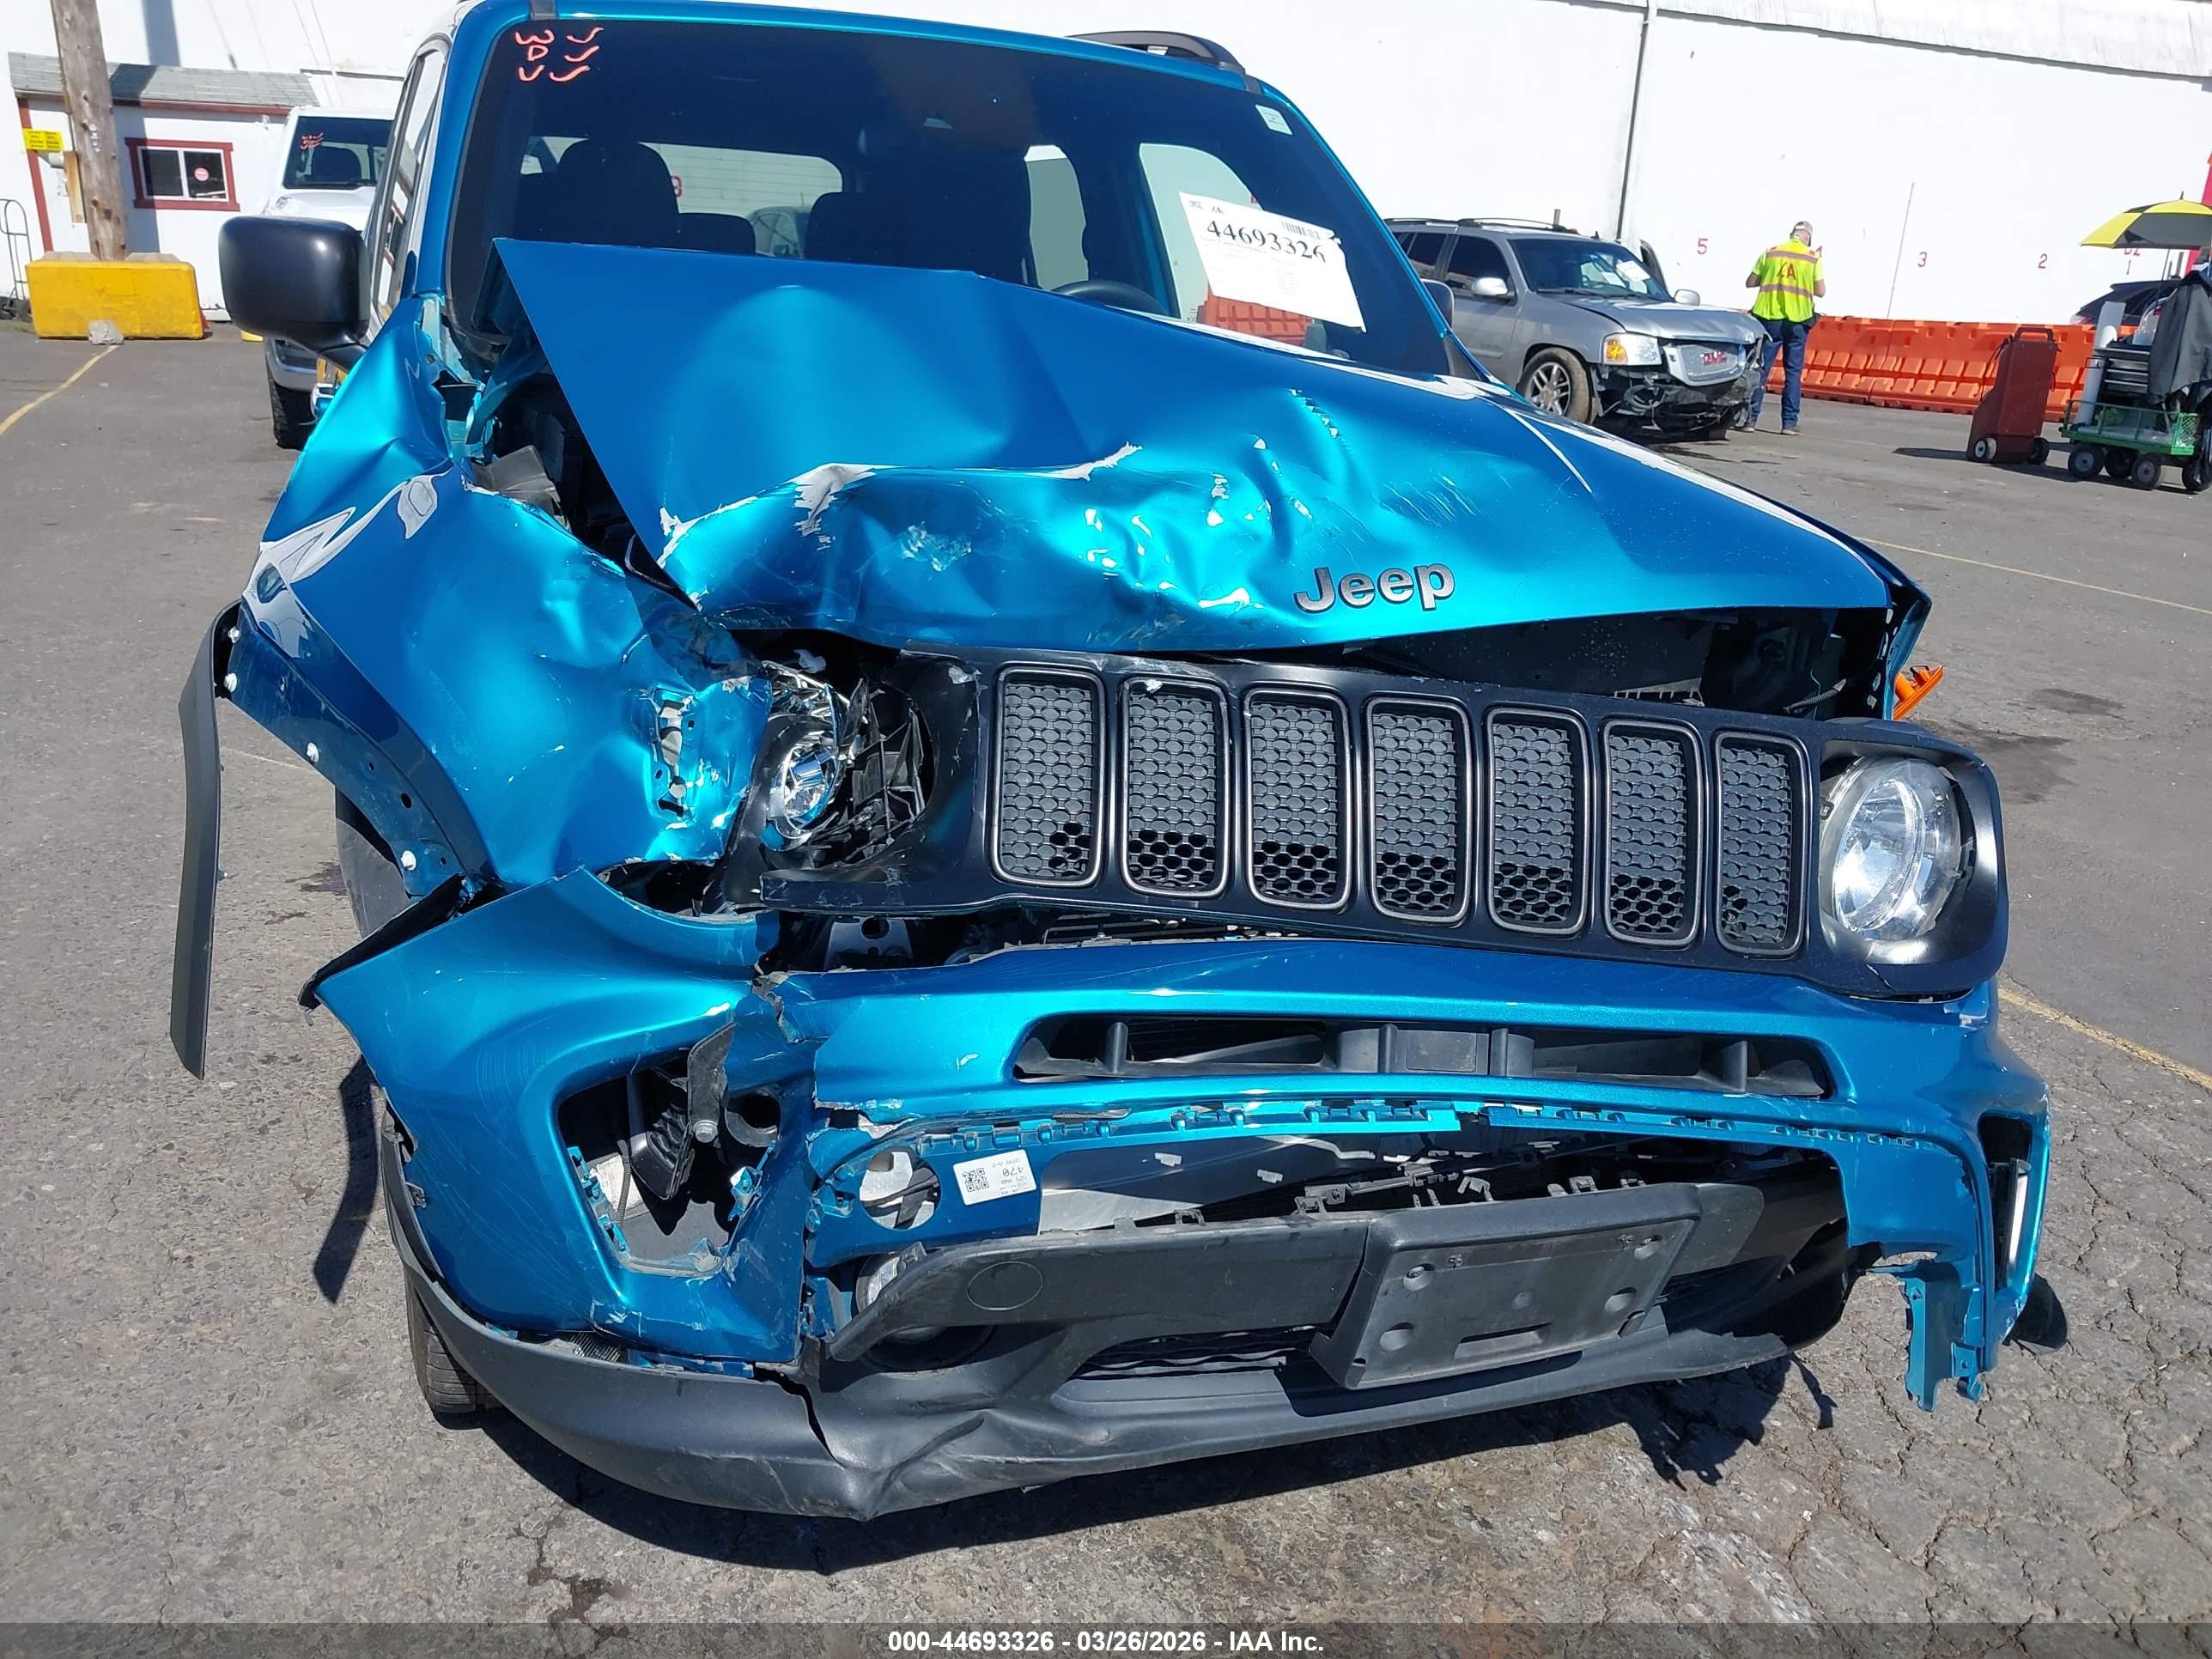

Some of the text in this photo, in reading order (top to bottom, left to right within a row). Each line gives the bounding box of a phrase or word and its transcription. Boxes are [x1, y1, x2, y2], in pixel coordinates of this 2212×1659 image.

[1206, 220, 1327, 263] 44693326
[1697, 238, 1709, 255] 5
[1917, 251, 1928, 268] 3
[2038, 253, 2048, 269] 2
[1294, 563, 1455, 614] Jeep
